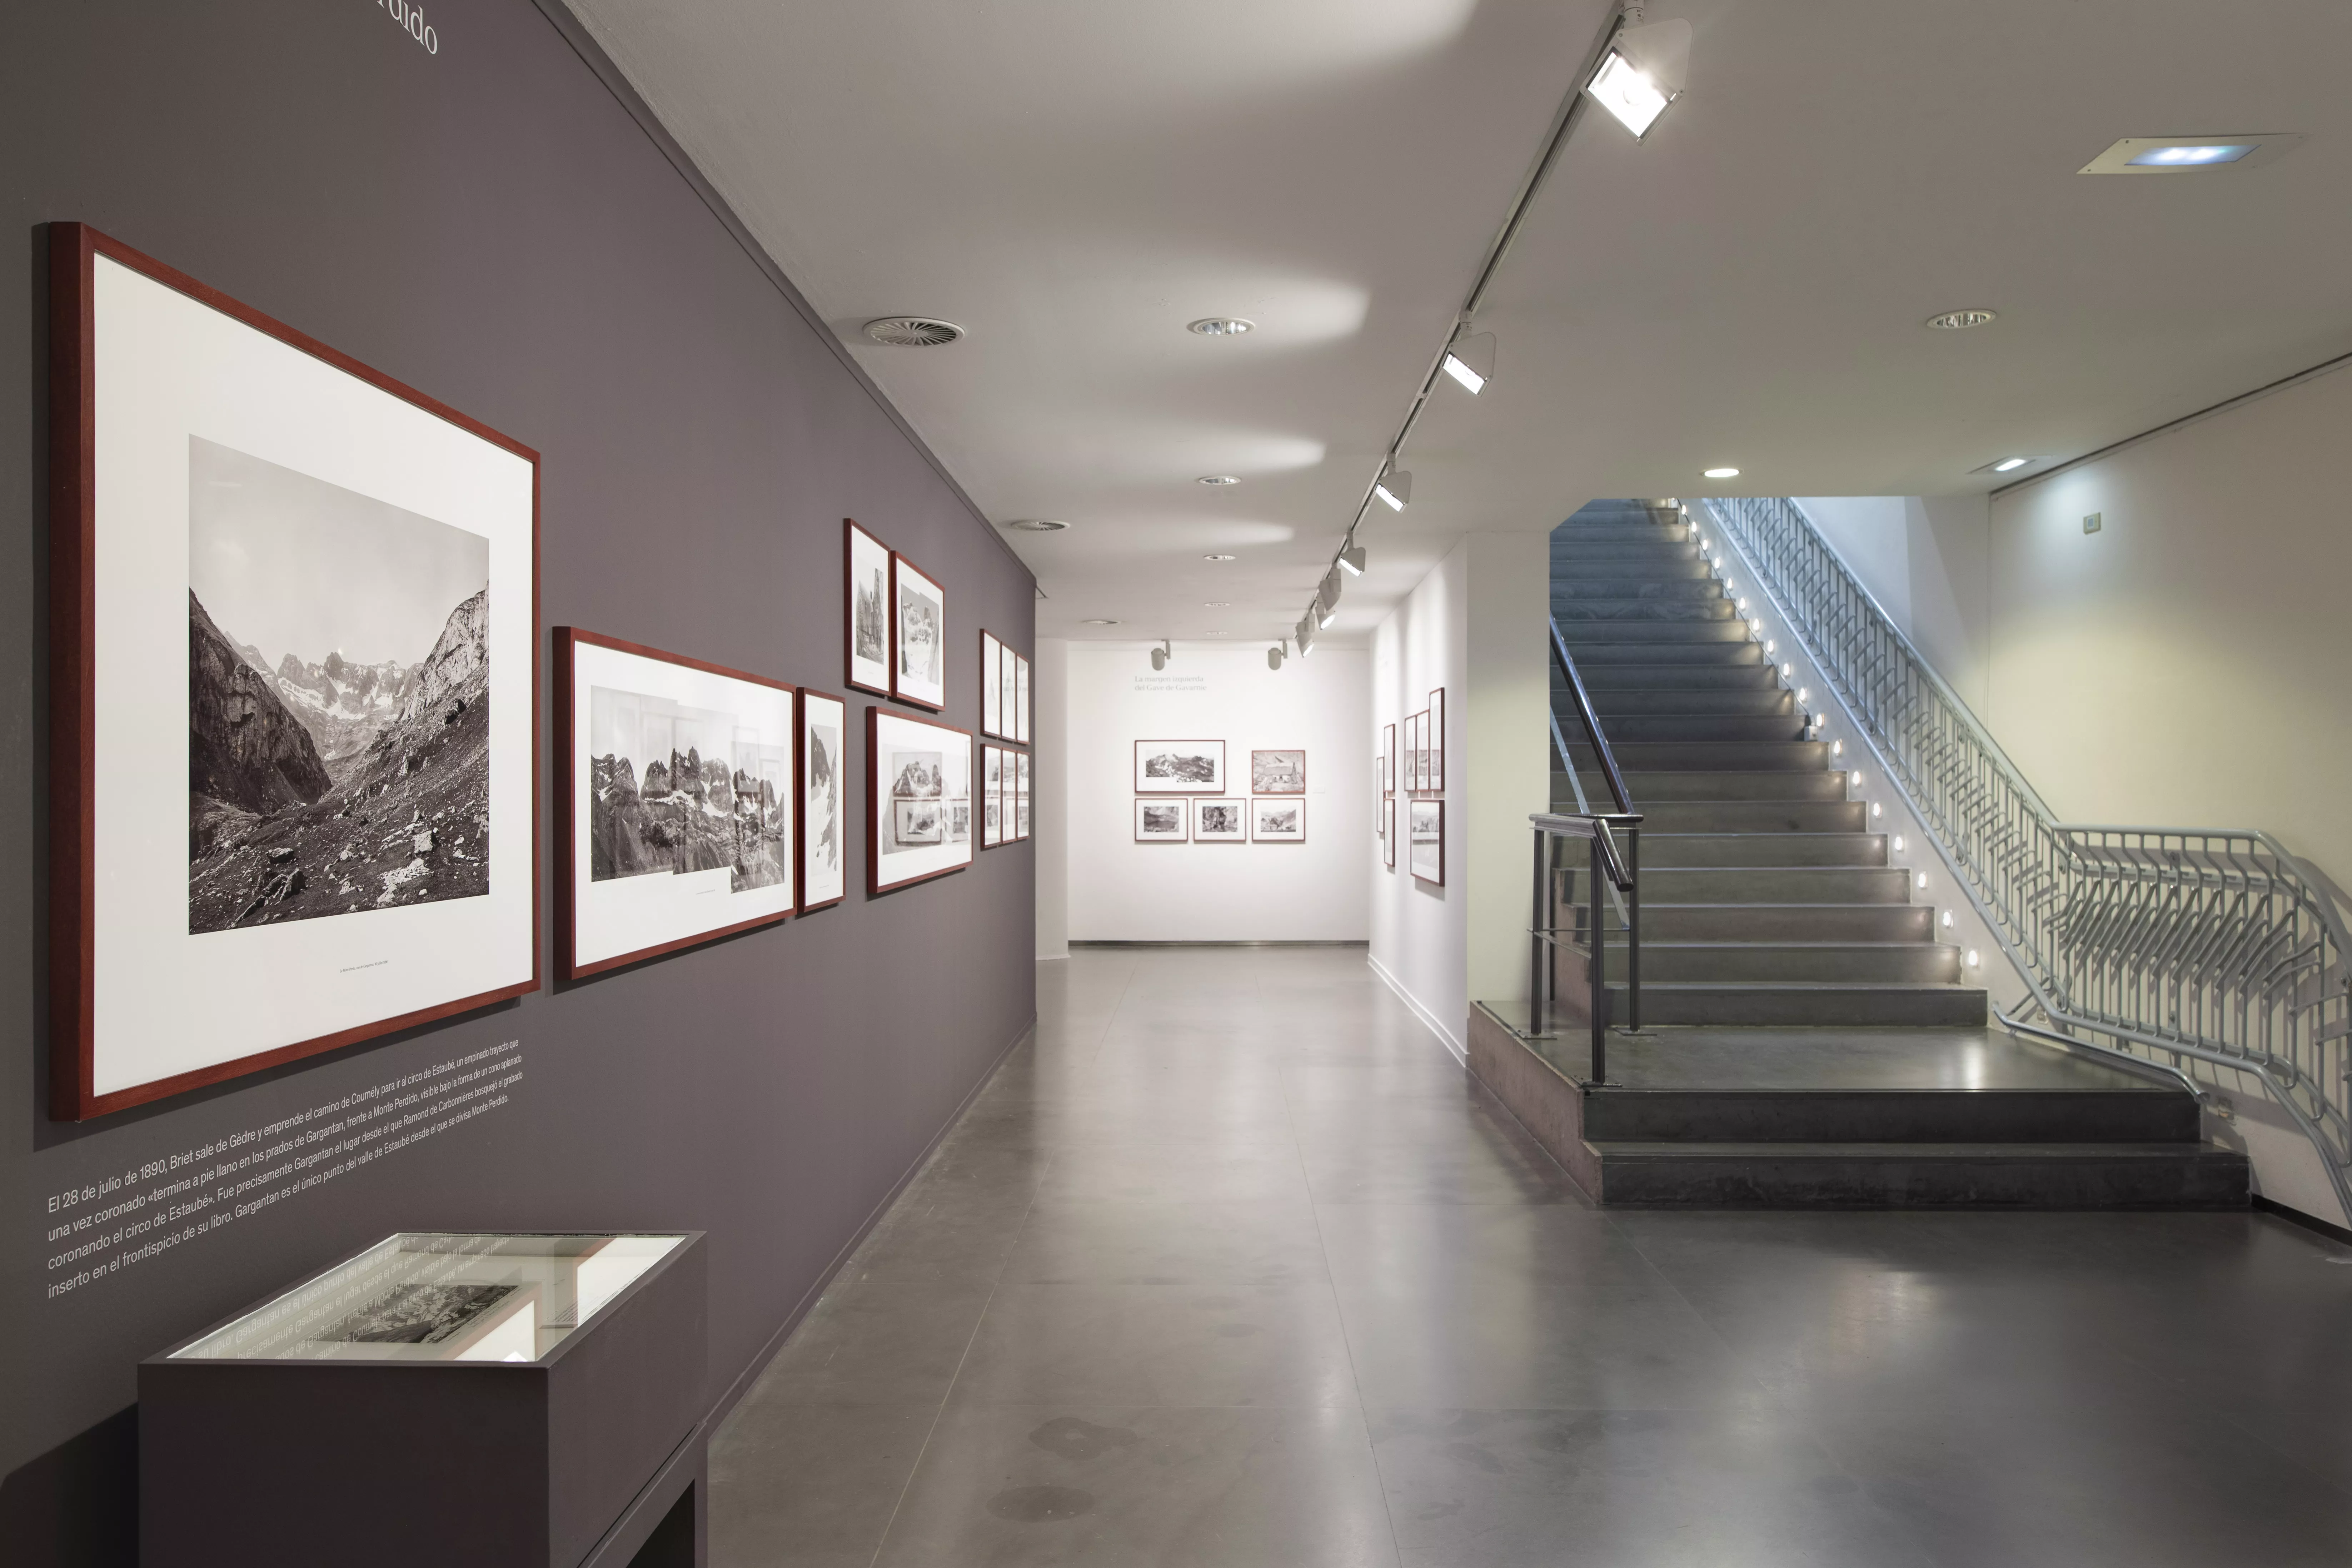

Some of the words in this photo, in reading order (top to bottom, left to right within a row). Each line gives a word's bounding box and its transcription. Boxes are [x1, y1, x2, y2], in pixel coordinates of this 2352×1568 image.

[377, 0, 438, 54] dido
[48, 1224, 70, 1241] una
[73, 1215, 92, 1232] vez
[95, 1194, 146, 1224] coronado
[148, 1179, 191, 1201] «termina
[193, 1176, 199, 1186] a
[201, 1168, 214, 1187] pie
[216, 1161, 238, 1178] llano
[239, 1157, 250, 1168] en
[252, 1151, 264, 1164] los
[266, 1140, 293, 1162] prados
[295, 1135, 305, 1148] de
[306, 1122, 345, 1143] Gargantan,
[347, 1112, 367, 1128] frente
[368, 1111, 373, 1120] a
[374, 1101, 393, 1117] Monte
[395, 1092, 419, 1109] Perdido,
[420, 1085, 439, 1099] visible
[439, 1080, 451, 1093] bajo
[452, 1077, 457, 1087] la
[457, 1073, 473, 1085] forma
[473, 1069, 480, 1079] de
[481, 1068, 488, 1076] un
[488, 1063, 500, 1074] cono
[501, 1054, 522, 1071] aplanado
[48, 1235, 110, 1270] coronando
[113, 1227, 123, 1244] el
[125, 1220, 151, 1238] circo
[153, 1212, 166, 1227] de
[169, 1193, 215, 1221] Estaubé».
[218, 1187, 234, 1201] Fue
[236, 1163, 293, 1197] precisamente
[294, 1147, 333, 1170] Gargantan
[335, 1141, 341, 1154] el
[343, 1136, 361, 1151] lugar
[362, 1126, 382, 1143] desde
[383, 1122, 389, 1134] el
[390, 1120, 403, 1133] que
[404, 1106, 429, 1126] Ramond
[430, 1104, 438, 1115] de
[438, 1091, 474, 1111] Carbonnières
[474, 1079, 498, 1097] bosquejó
[498, 1077, 503, 1087] el
[504, 1070, 523, 1088] grabado
[49, 1195, 59, 1213] El
[63, 1189, 79, 1208] 28
[81, 1185, 96, 1201] de
[98, 1176, 121, 1199] julio
[124, 1170, 137, 1186] de
[139, 1159, 167, 1180] 1890,
[170, 1150, 193, 1170] Briet
[195, 1144, 214, 1160] sale
[216, 1139, 228, 1153] de
[229, 1130, 256, 1148] Gèdre
[257, 1128, 263, 1142] y
[264, 1112, 304, 1136] emprende
[305, 1108, 312, 1121] el
[314, 1101, 340, 1118] camino
[341, 1096, 350, 1109] de
[351, 1085, 380, 1105] Coumély
[381, 1082, 395, 1097] para
[396, 1078, 401, 1089] ir
[401, 1075, 407, 1087] al
[408, 1073, 423, 1084] circo
[423, 1068, 431, 1079] de
[432, 1059, 456, 1076] Estaubé,
[457, 1058, 463, 1067] un
[464, 1048, 489, 1064] empinado
[489, 1041, 509, 1056] trayecto
[509, 1039, 519, 1050] que
[49, 1271, 90, 1299] inserto
[93, 1265, 107, 1279] en
[110, 1255, 119, 1271] el
[122, 1232, 180, 1266] frontispicio
[183, 1226, 195, 1240] de
[197, 1221, 208, 1234] su
[211, 1213, 233, 1229] libro.
[235, 1192, 279, 1218] Gargantan
[281, 1187, 291, 1198] es
[292, 1180, 299, 1194] el
[301, 1174, 322, 1190] único
[323, 1164, 344, 1184] punto
[346, 1156, 356, 1171] del
[358, 1150, 373, 1165] valle
[374, 1146, 383, 1158] de
[384, 1134, 410, 1154] Estaubé
[410, 1127, 429, 1143] desde
[430, 1123, 436, 1134] el
[437, 1121, 448, 1133] que
[448, 1117, 455, 1126] se
[456, 1110, 471, 1123] divisa
[472, 1102, 488, 1116] Monte
[489, 1094, 509, 1109] Perdido.
